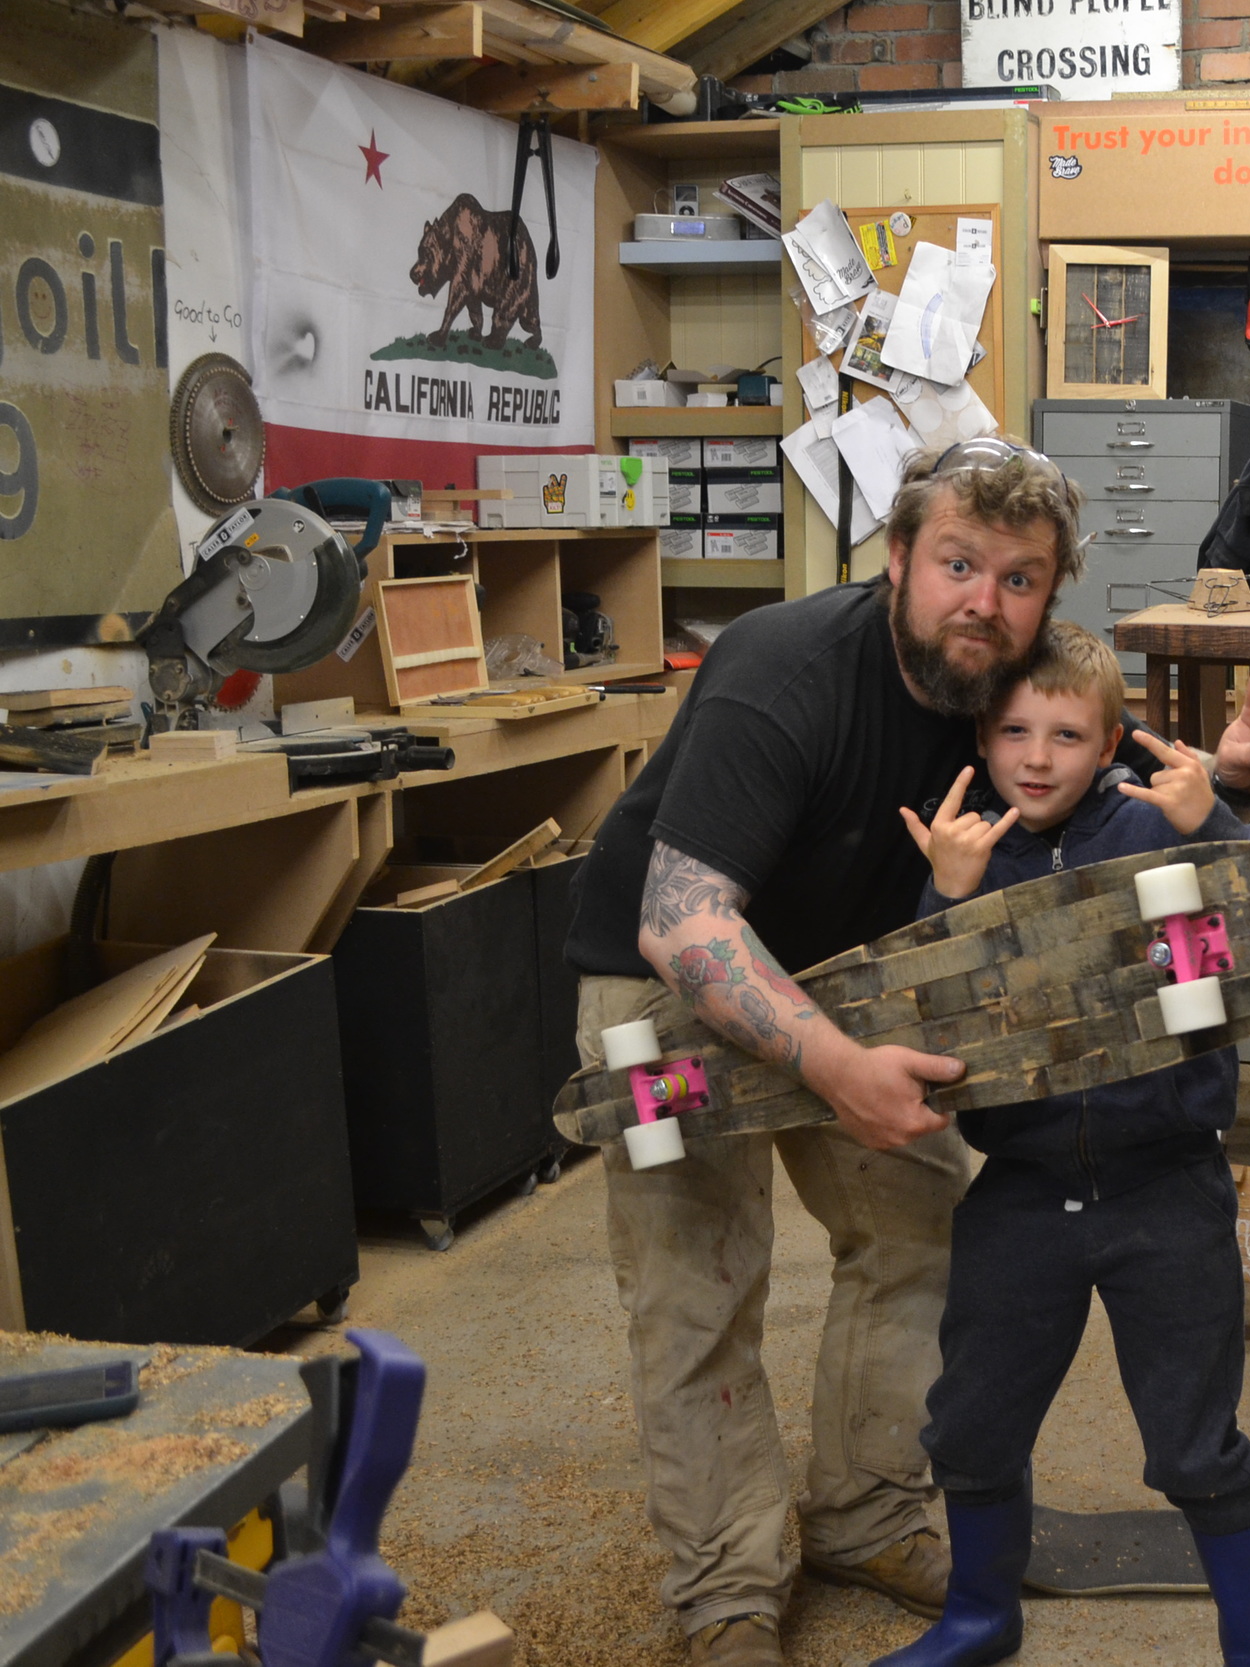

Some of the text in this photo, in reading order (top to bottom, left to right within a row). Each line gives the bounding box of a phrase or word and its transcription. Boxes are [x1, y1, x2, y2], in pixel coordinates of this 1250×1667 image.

[997, 43, 1151, 82] CROSSING
[1053, 125, 1129, 151] Trust
[1139, 126, 1212, 155] your
[1050, 156, 1077, 168] Made
[1052, 166, 1081, 179] Brave
[837, 257, 856, 280] Made
[174, 300, 205, 323] Good
[206, 305, 220, 323] to
[364, 369, 560, 426] CALIFORNIA REPUBLIC
[203, 538, 221, 557] CALEB
[227, 513, 249, 534] TAYLOR
[341, 637, 356, 657] CALEB
[359, 611, 375, 632] TAYLOR
